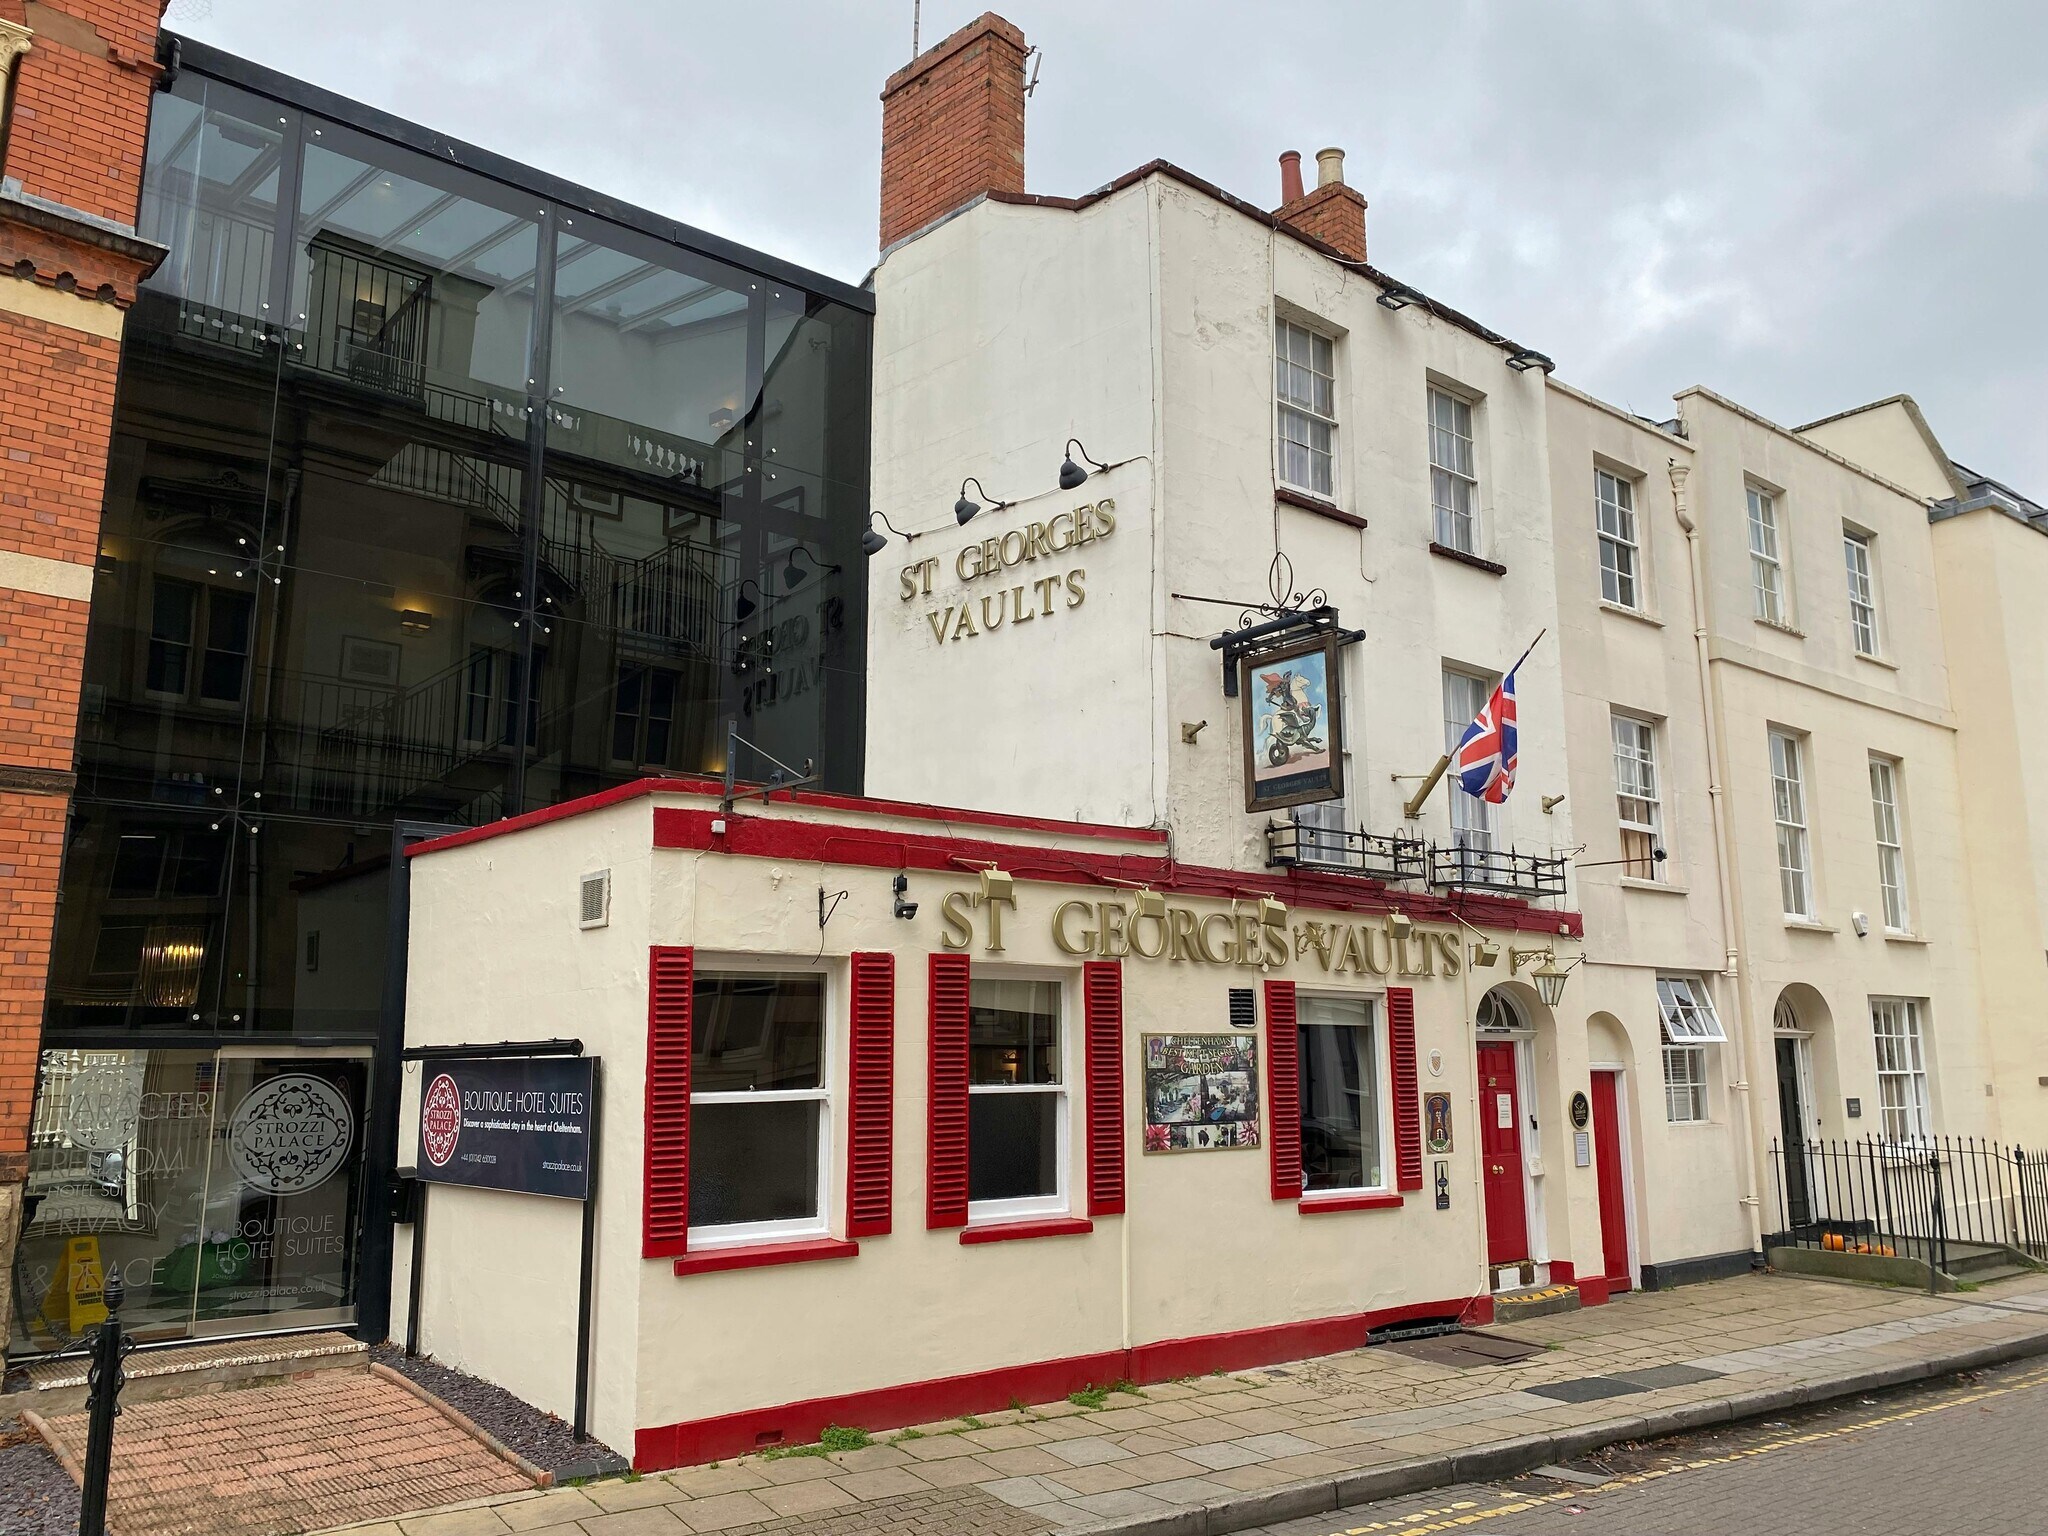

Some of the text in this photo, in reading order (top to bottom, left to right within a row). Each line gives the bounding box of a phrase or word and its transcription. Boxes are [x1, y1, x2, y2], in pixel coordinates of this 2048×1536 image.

[900, 498, 1116, 602] ST GEORGES
[926, 568, 1086, 645] VAULTS
[941, 891, 1462, 977] ST GEORGES VAULTS
[1161, 1048, 1184, 1057] BEST
[1180, 1062, 1225, 1075] GARDEN
[429, 1108, 453, 1119] STROZZI
[464, 1091, 583, 1115] BOUTIQUE HOTEL SUITES
[255, 1122, 326, 1134] STROZZI
[429, 1120, 452, 1131] PALACE
[463, 1117, 479, 1128] Discover
[480, 1121, 484, 1129] a
[484, 1118, 510, 1132] sophisticated
[511, 1120, 520, 1133] stay
[521, 1120, 526, 1131] in
[526, 1120, 534, 1131] the
[534, 1121, 546, 1132] heart
[546, 1121, 553, 1132] of
[253, 1134, 326, 1149] PALACE
[47, 1184, 95, 1199] HOTEL
[42, 1201, 168, 1239] PRIVACY
[232, 1214, 335, 1239] BOUTIQUE
[215, 1235, 345, 1262] HOTEL SUITES
[32, 1256, 167, 1296] & PEACE
[228, 1280, 328, 1302] strozzipalace.co.uk
